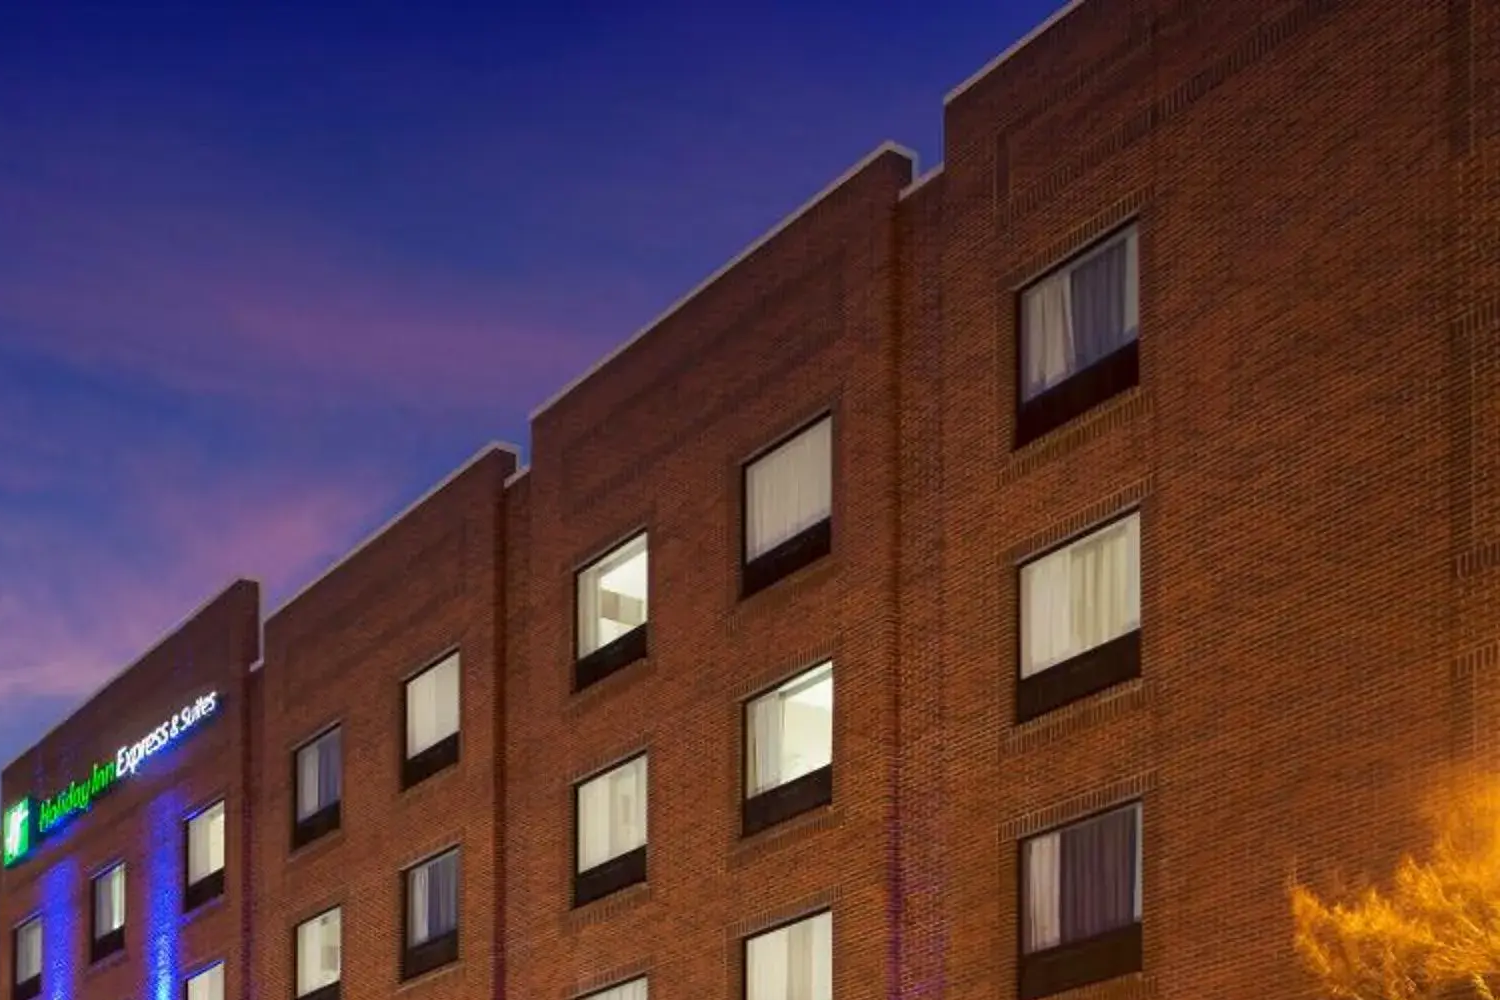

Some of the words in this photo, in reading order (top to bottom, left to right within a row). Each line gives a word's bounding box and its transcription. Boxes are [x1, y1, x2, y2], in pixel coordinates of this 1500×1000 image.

[39, 779, 90, 832] Holiday
[91, 762, 115, 794] Inn
[116, 721, 169, 777] Express
[169, 714, 179, 738] &
[180, 691, 217, 731] Suites
